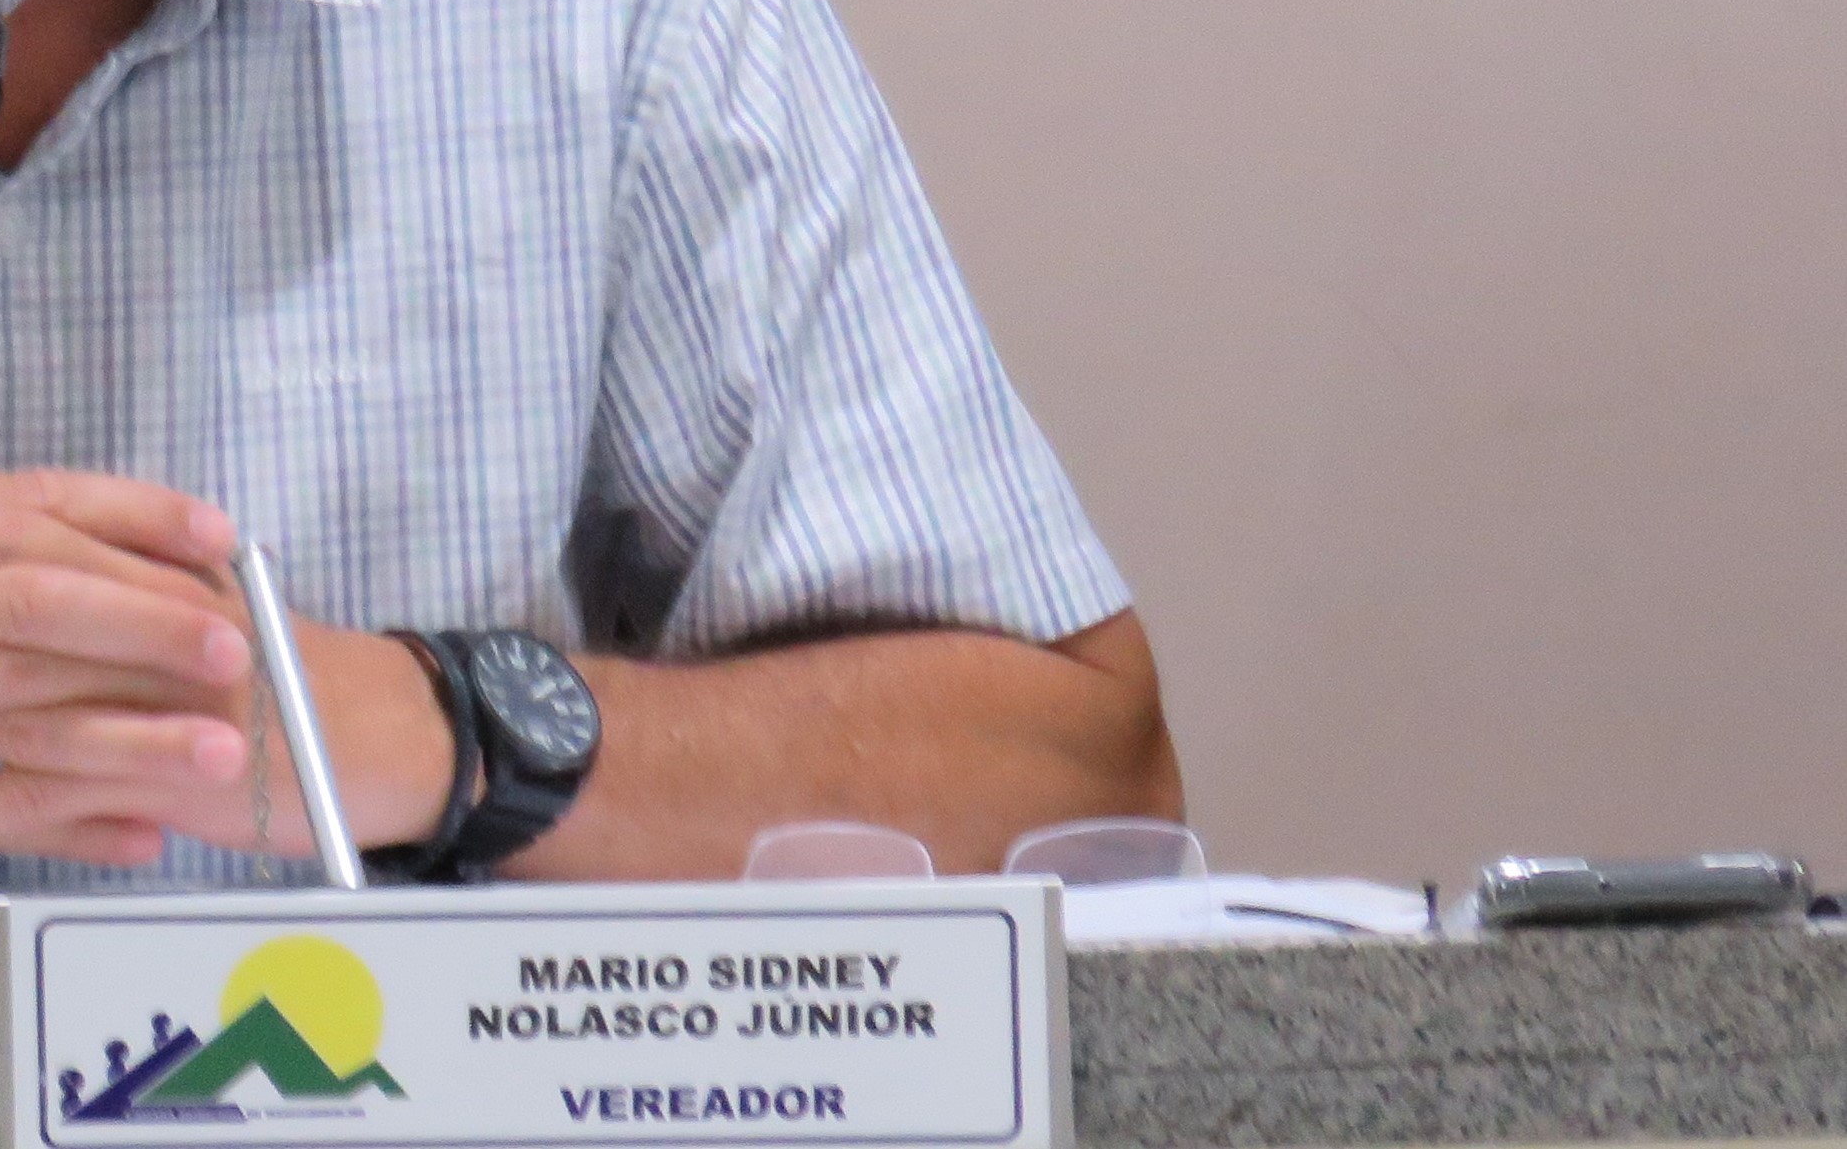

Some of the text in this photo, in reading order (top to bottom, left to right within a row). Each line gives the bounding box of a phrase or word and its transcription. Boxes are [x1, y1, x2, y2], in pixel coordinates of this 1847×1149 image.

[519, 955, 898, 991] MARIO SIDNEY
[468, 994, 937, 1039] NOLASCO JÚNIOR
[560, 1085, 845, 1121] VEREADOR
